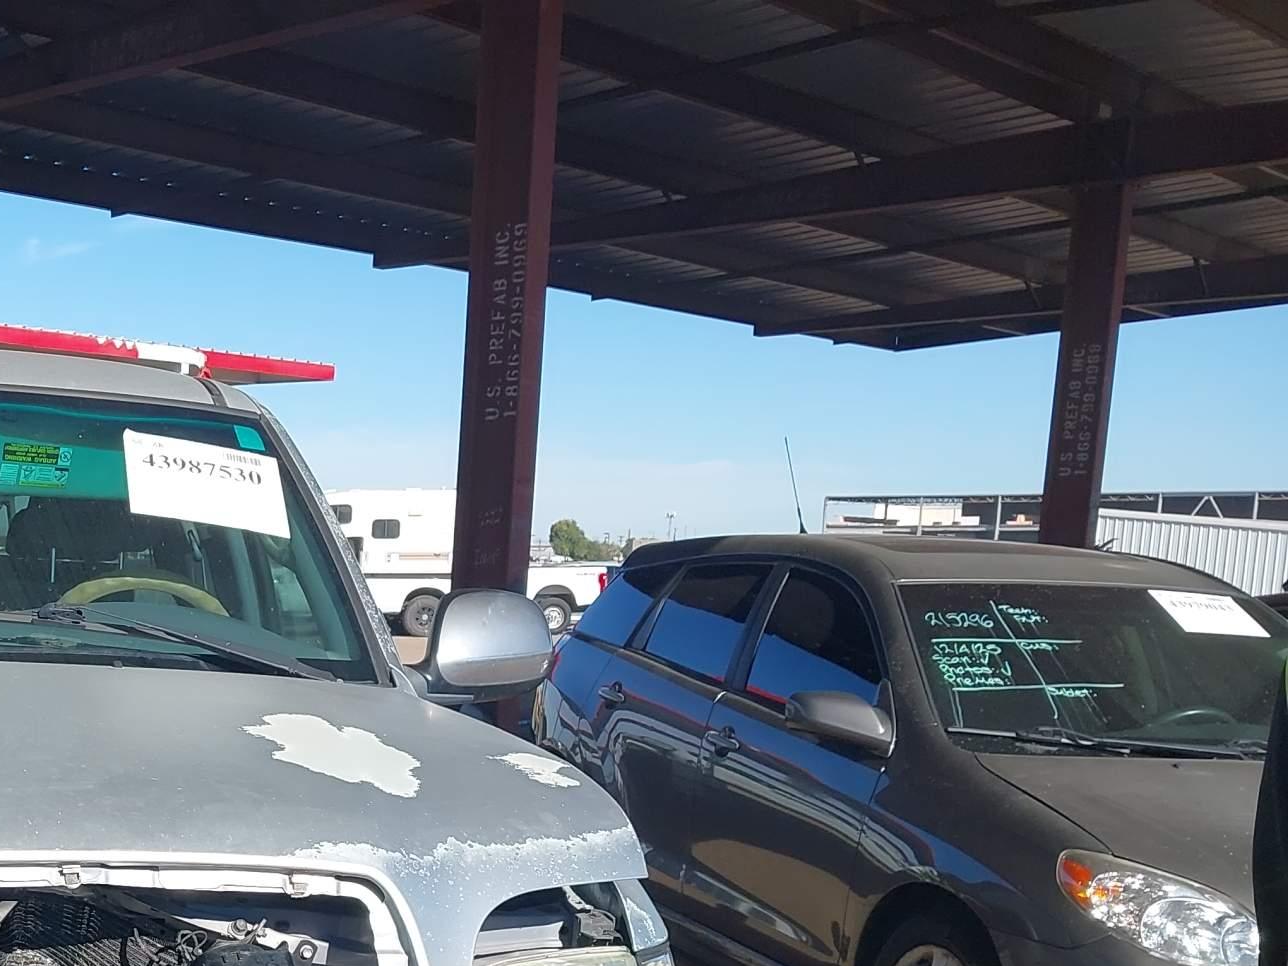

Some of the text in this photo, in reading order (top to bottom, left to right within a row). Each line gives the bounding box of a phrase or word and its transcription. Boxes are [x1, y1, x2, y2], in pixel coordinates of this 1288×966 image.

[494, 222, 513, 266] INC.
[488, 278, 508, 366] PREFAB
[1064, 379, 1083, 440] PREFAB
[142, 453, 262, 485] 43987530
[924, 611, 995, 628] 215296
